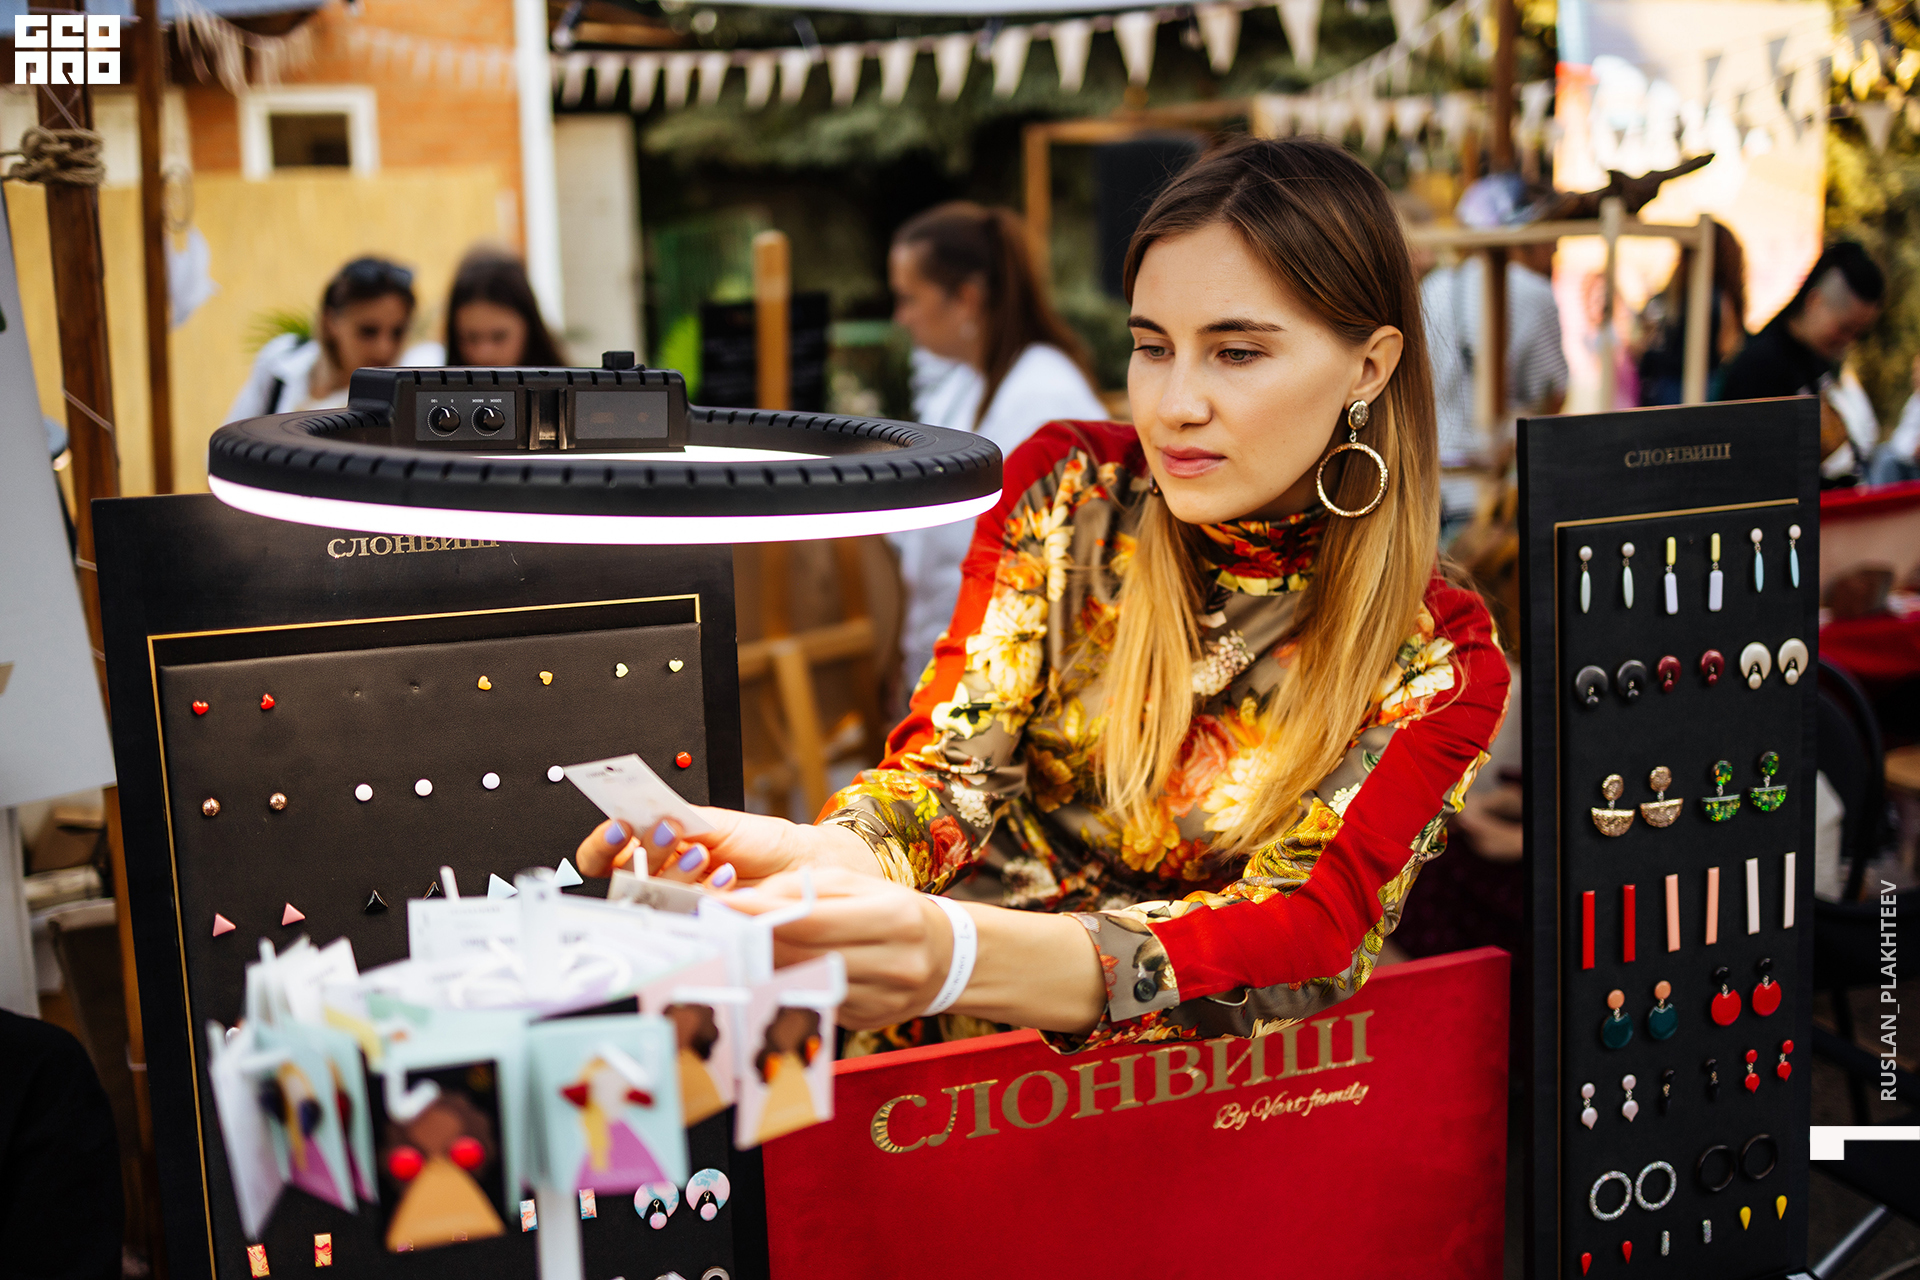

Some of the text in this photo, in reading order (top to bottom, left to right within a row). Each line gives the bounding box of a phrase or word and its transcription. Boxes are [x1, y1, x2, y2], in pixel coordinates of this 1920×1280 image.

[1624, 442, 1732, 468] СЛОНВИШ
[870, 1010, 1375, 1154] СЛОНВИШ
[1213, 1102, 1250, 1131] By
[1301, 1081, 1369, 1117] family
